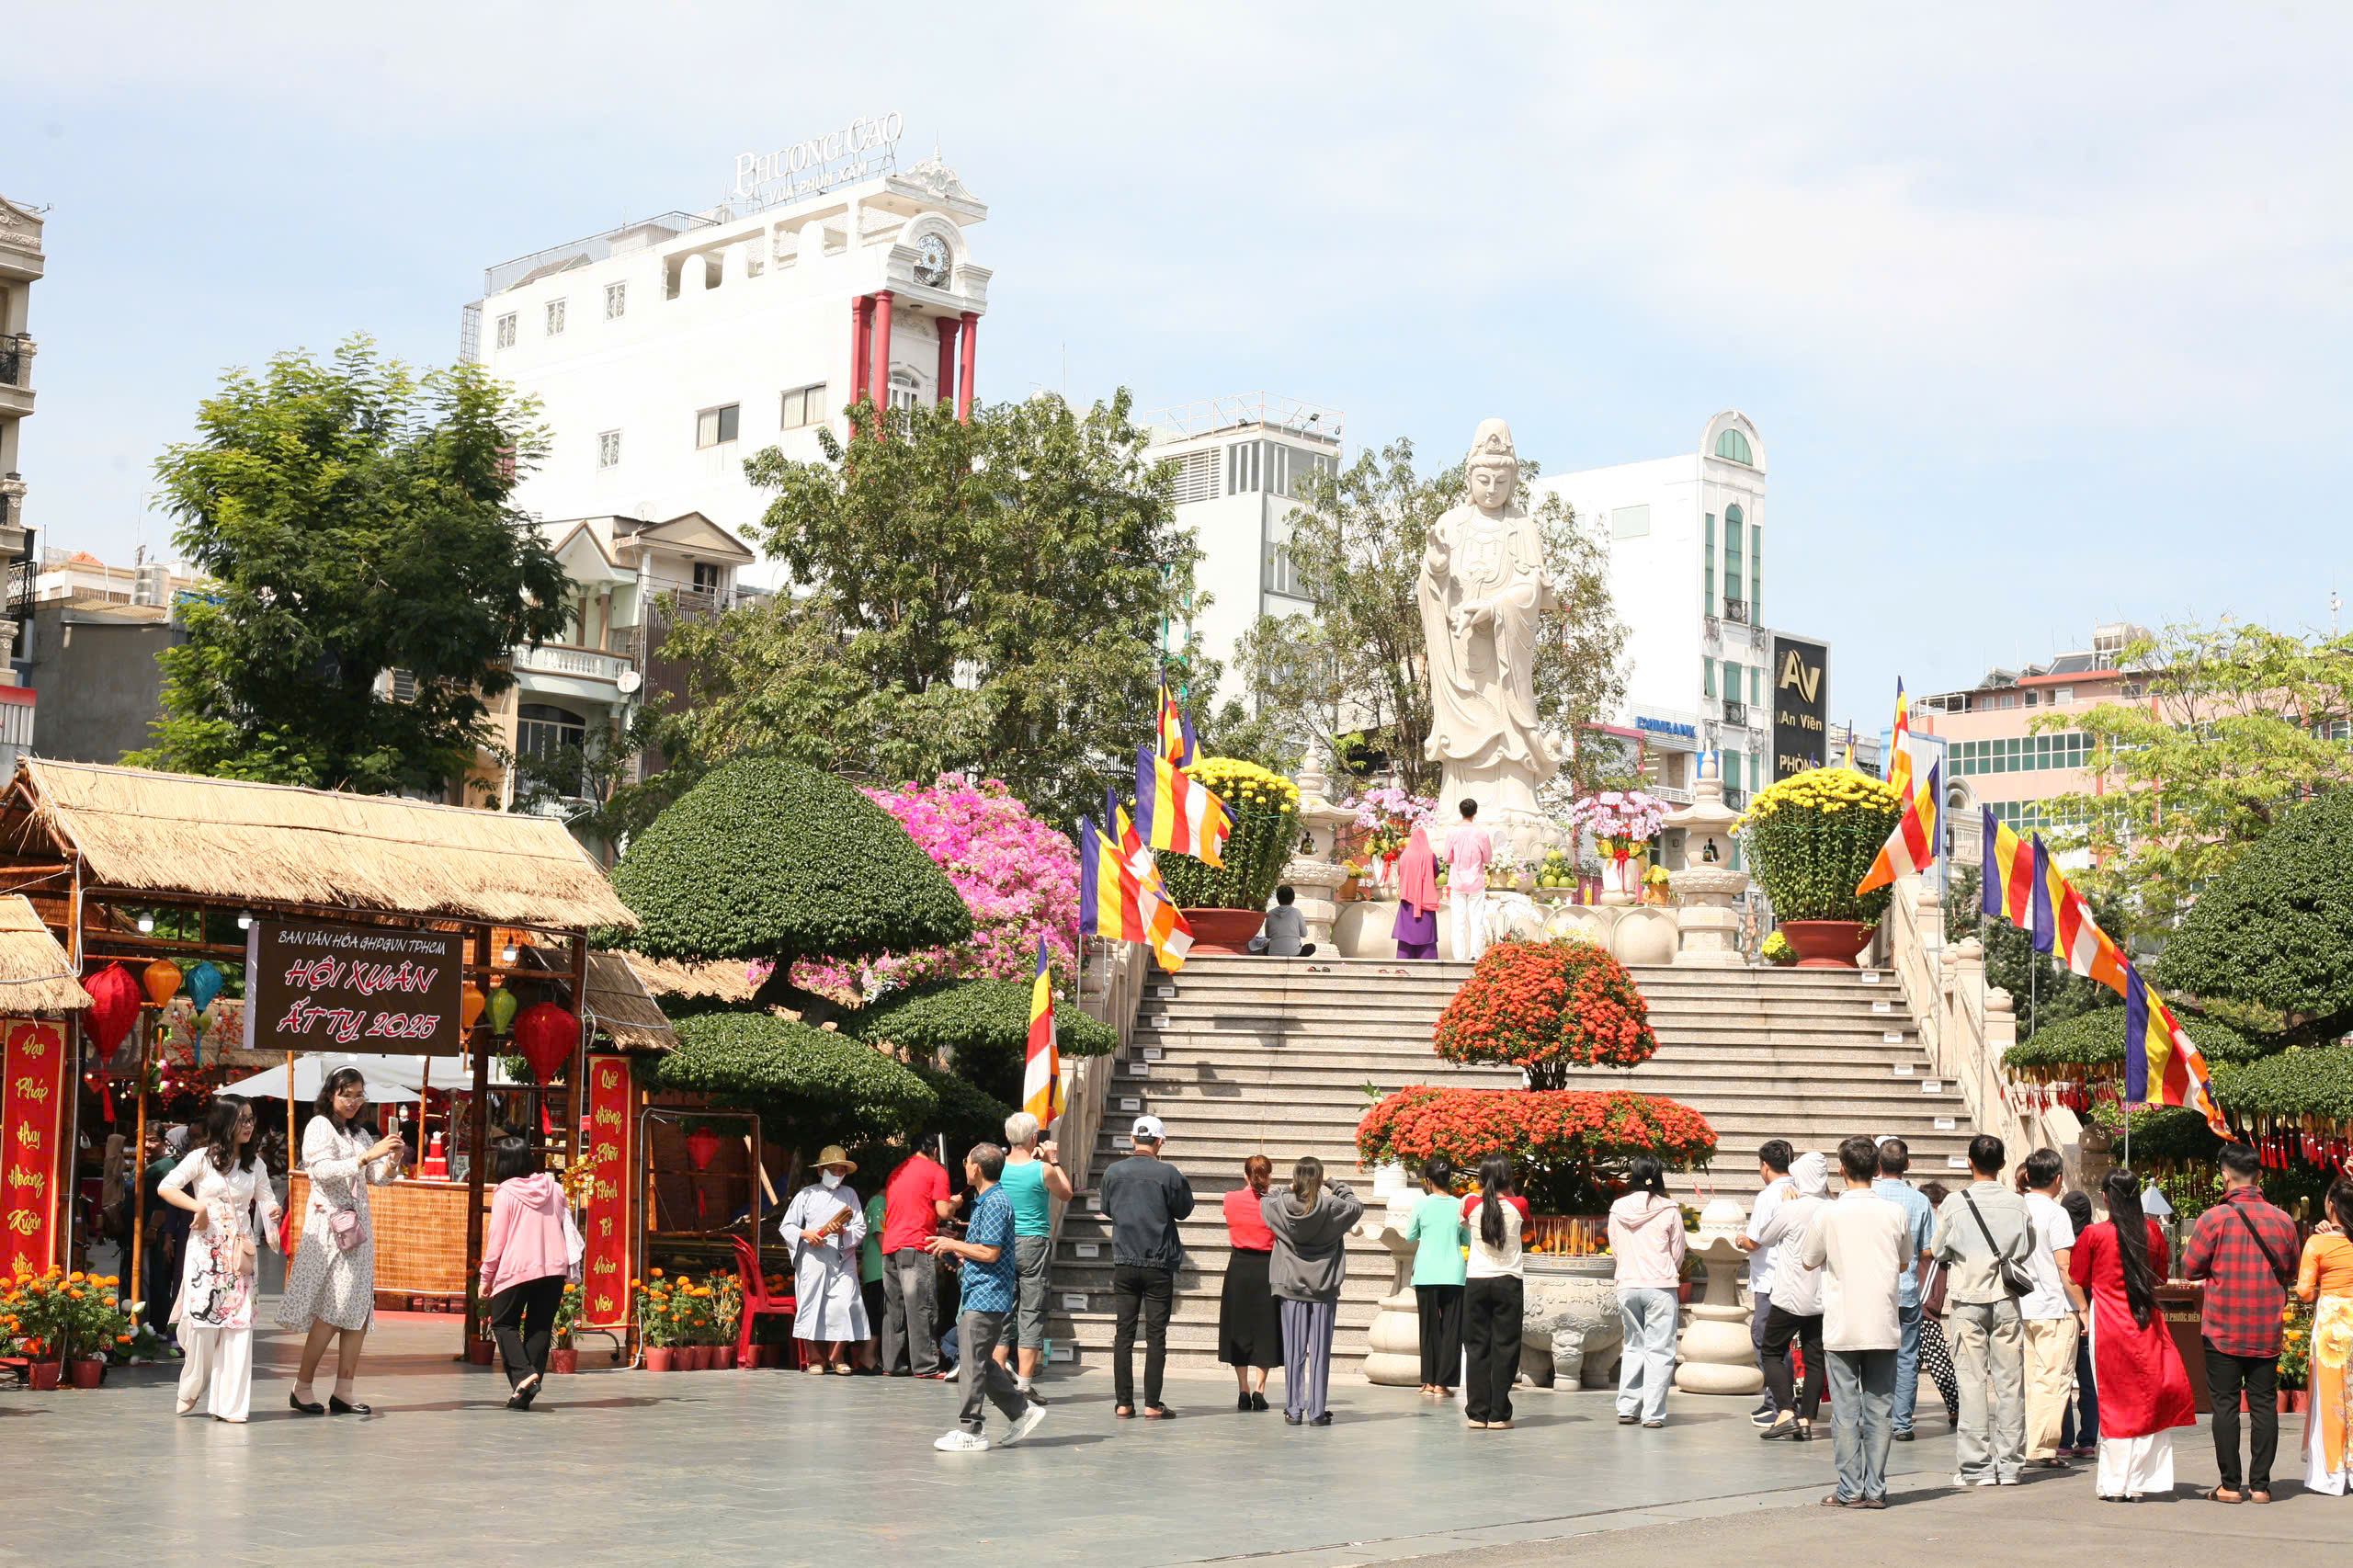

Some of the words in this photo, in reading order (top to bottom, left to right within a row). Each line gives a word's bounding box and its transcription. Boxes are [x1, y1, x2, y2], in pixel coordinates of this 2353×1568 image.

[847, 110, 904, 154] CAO
[1780, 710, 1796, 726] An
[1800, 714, 1823, 732] Viên
[278, 930, 306, 945] BAN
[306, 930, 332, 947] VĂN
[332, 932, 358, 949] HÓA
[359, 937, 408, 953] GHPGVN
[408, 939, 446, 956] TPHCM
[285, 955, 346, 992] HỘI
[344, 960, 438, 996] XUÂN
[277, 996, 327, 1034] ẤT
[365, 1013, 441, 1040] 2025
[21, 1033, 45, 1059] Đạo
[16, 1076, 49, 1104] Pháp
[17, 1120, 41, 1150] Huy
[8, 1164, 45, 1199] Hoàng
[7, 1209, 41, 1236] Xuân
